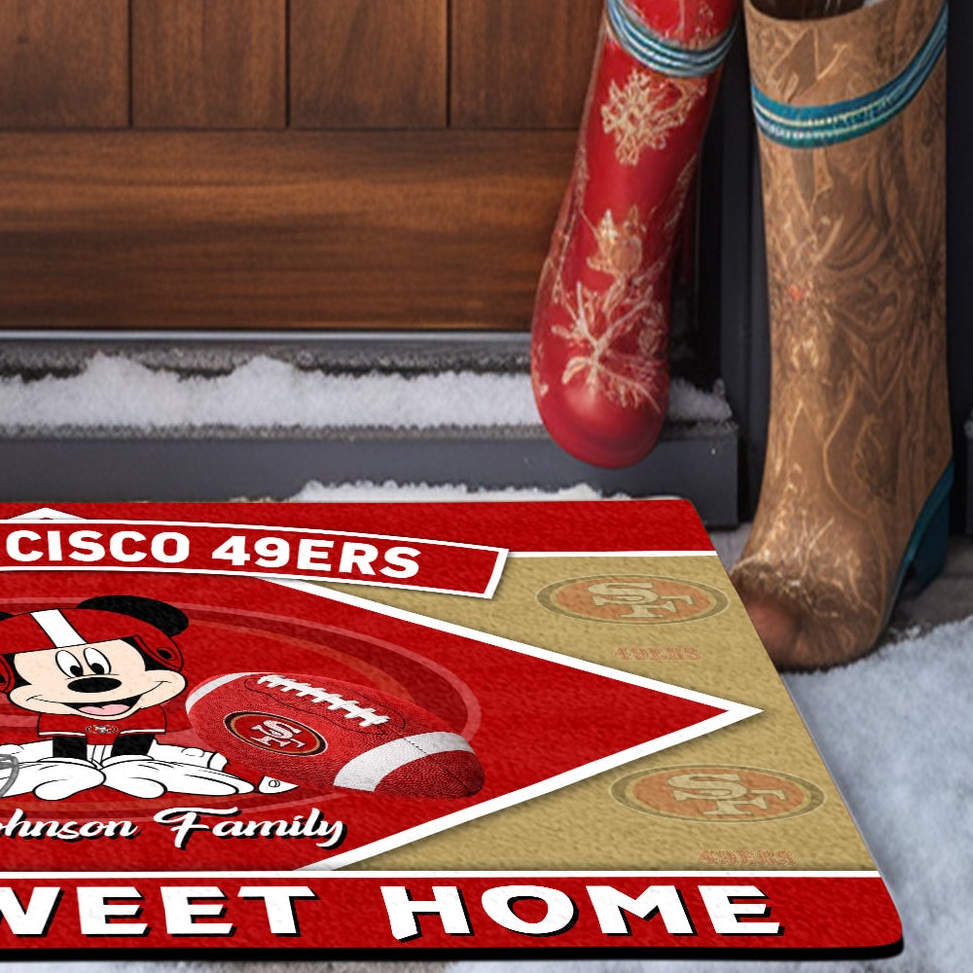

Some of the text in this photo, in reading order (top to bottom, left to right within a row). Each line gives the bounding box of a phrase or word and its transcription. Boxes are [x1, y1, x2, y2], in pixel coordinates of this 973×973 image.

[211, 535, 422, 579] 49ERS
[152, 806, 344, 849] Family
[379, 884, 781, 941] HOME
